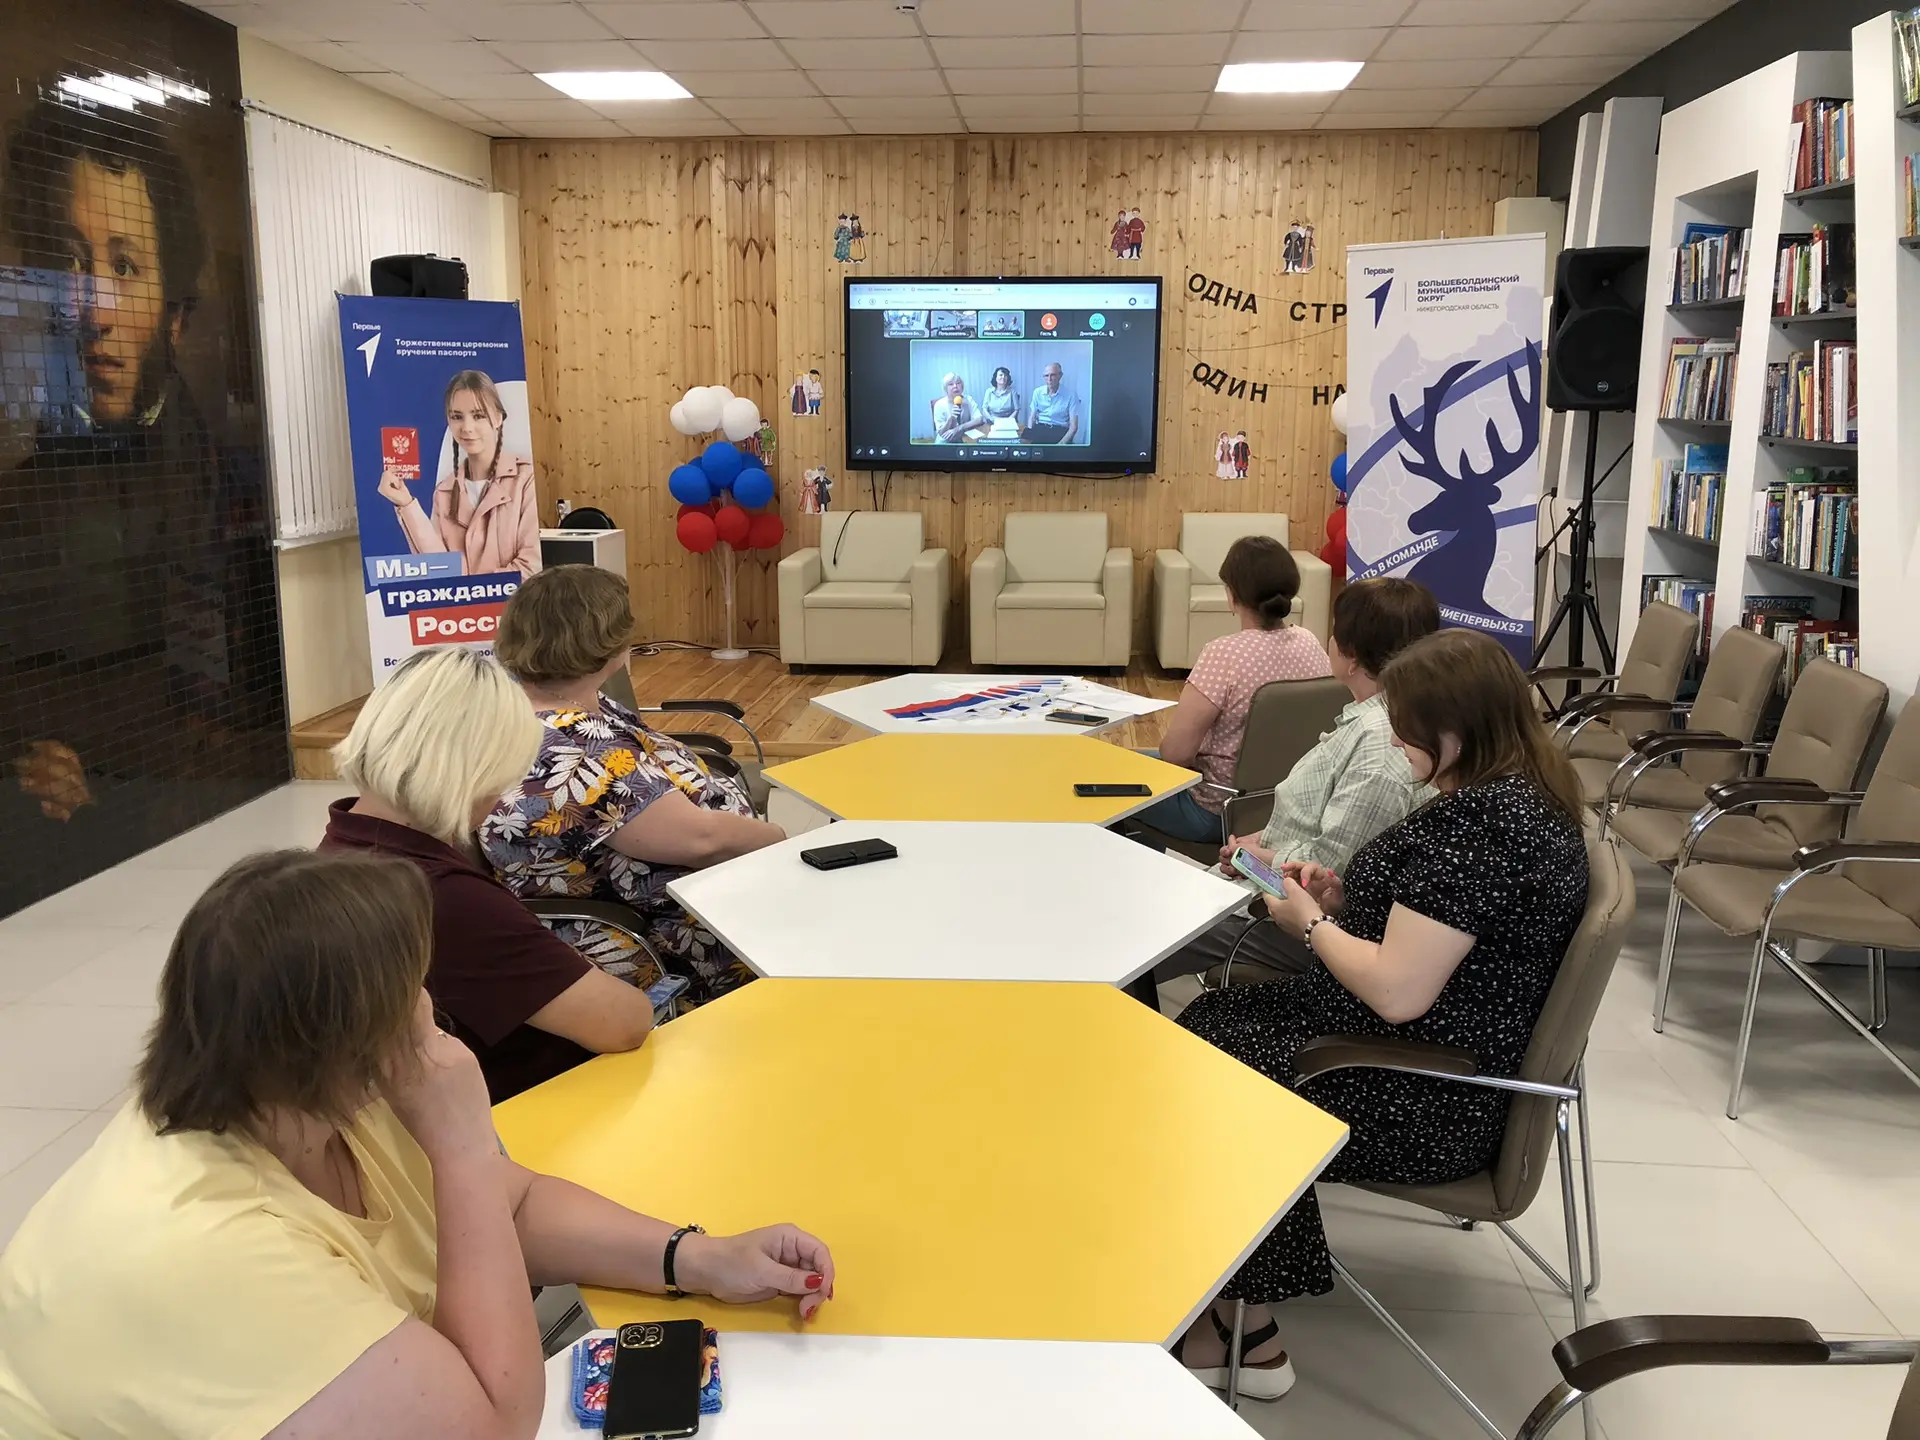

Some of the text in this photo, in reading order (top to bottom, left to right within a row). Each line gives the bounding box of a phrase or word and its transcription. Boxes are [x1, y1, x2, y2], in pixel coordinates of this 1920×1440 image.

[1364, 267, 1395, 277] Первые
[1417, 274, 1520, 288] БОЛЬШЕБОЛДИНСКИЙ
[1417, 284, 1501, 296] МУНИЦИПАЛЬНЫЙ
[1189, 273, 1347, 323] ОДНА СТР
[1417, 294, 1445, 303] ОКРУГ
[1416, 303, 1499, 313] НИЖЕГОРОДСКАЯ ОБЛАСТЬ
[352, 322, 381, 331] Первые
[395, 338, 509, 350] Торжественная церемония
[396, 349, 478, 358] вручения паспорта
[1192, 362, 1268, 403] ОДИН
[1377, 561, 1386, 572] В
[1385, 536, 1440, 568] КОМАНДЕ
[387, 582, 519, 608] граждане
